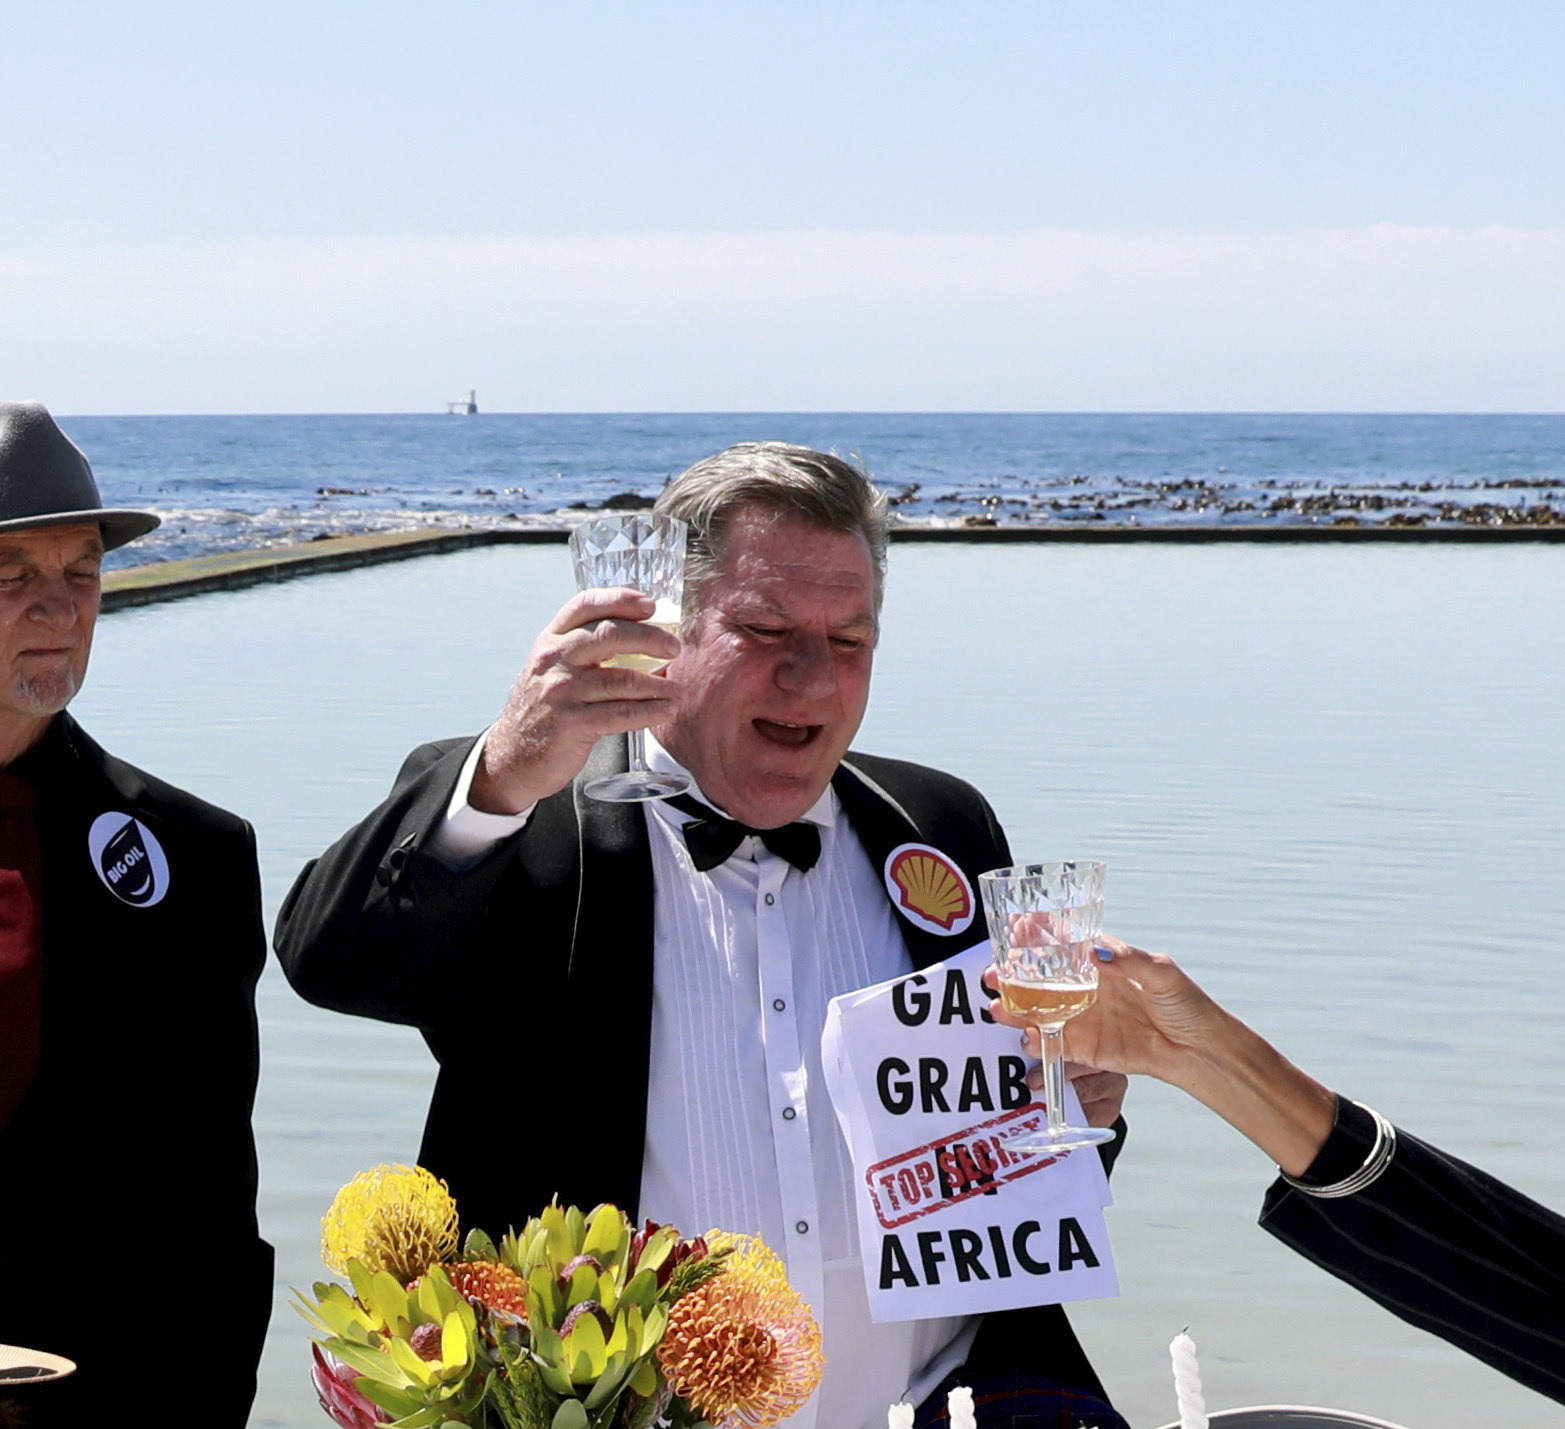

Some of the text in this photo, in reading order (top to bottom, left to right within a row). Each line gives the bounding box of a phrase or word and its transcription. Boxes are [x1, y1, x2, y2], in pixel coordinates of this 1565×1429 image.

[107, 846, 144, 884] BIG OIL
[876, 1055, 1032, 1115] GRAB
[879, 1161, 935, 1211] TOP
[879, 1217, 1100, 1290] AFRICA
